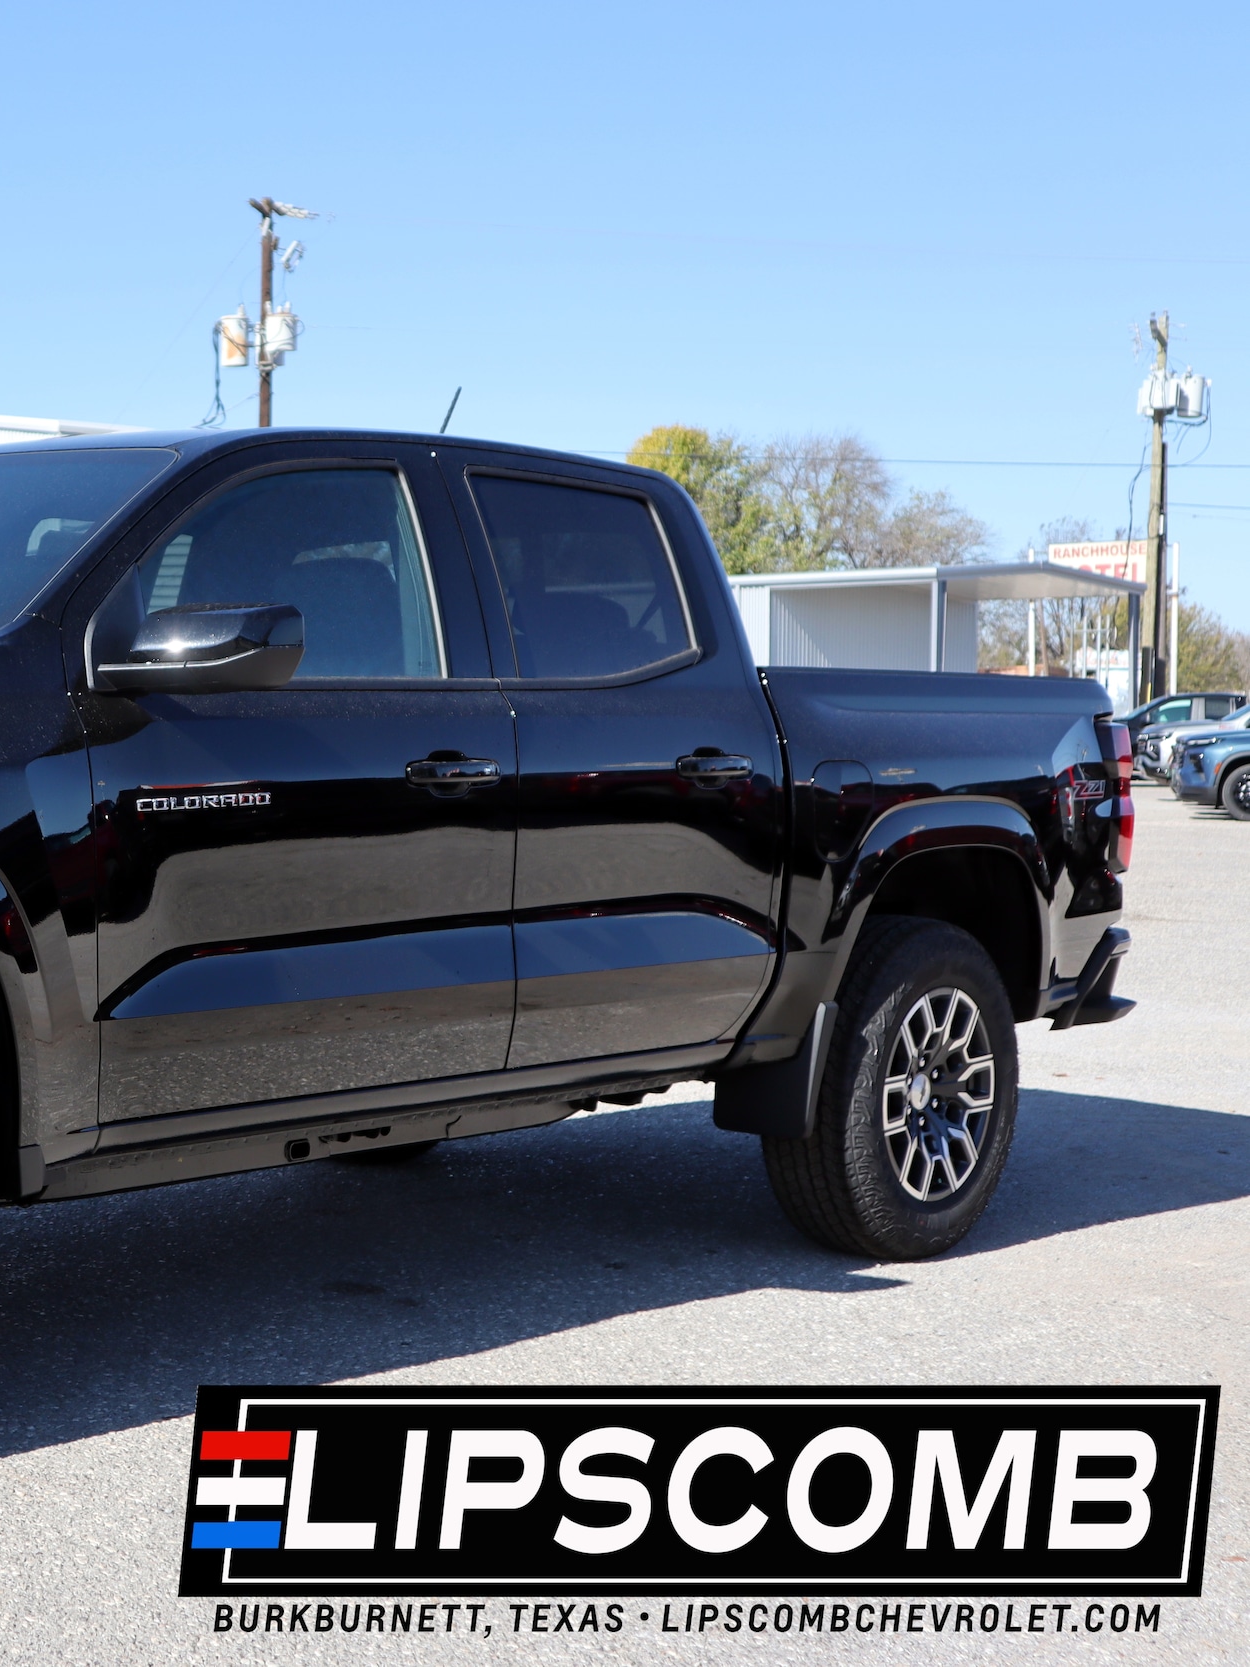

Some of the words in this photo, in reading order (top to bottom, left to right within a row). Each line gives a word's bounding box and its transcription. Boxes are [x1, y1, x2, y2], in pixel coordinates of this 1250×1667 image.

[1053, 542, 1146, 559] RANCHHOUSE
[1072, 780, 1105, 800] Z71
[136, 791, 271, 812] COLORADO
